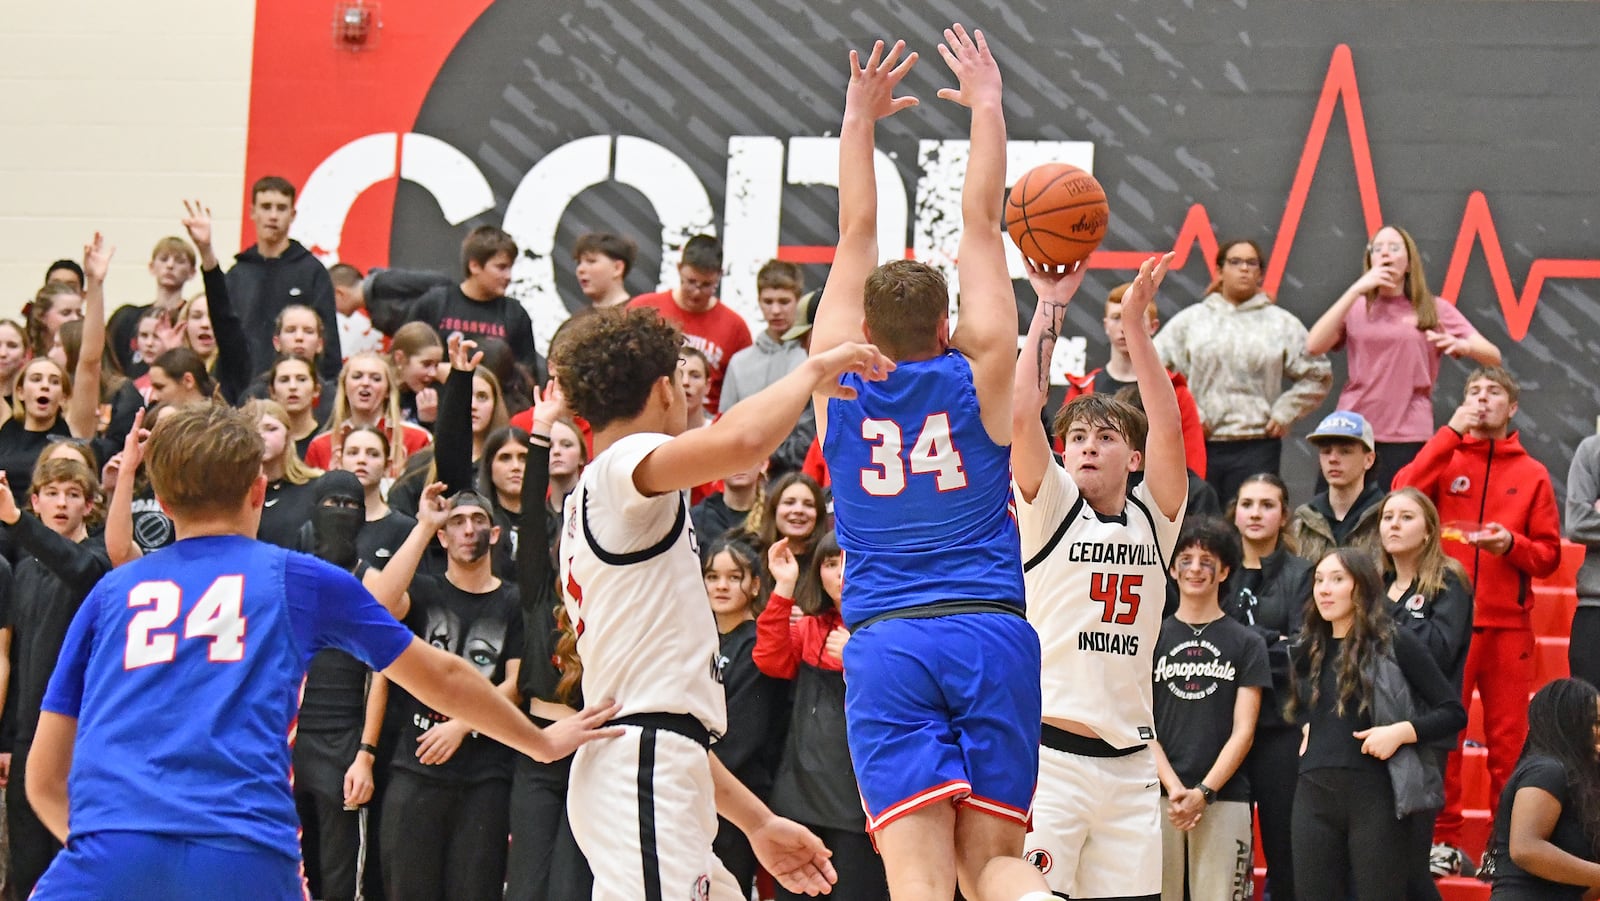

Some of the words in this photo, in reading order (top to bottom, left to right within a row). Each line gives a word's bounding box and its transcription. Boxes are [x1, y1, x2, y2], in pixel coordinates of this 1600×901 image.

[860, 411, 968, 497] 34
[1069, 542, 1157, 566] CEDARVILLE
[1090, 572, 1144, 625] 45
[124, 574, 248, 671] 24
[1078, 631, 1140, 656] INDIANS
[1154, 655, 1236, 682] Aeropostale
